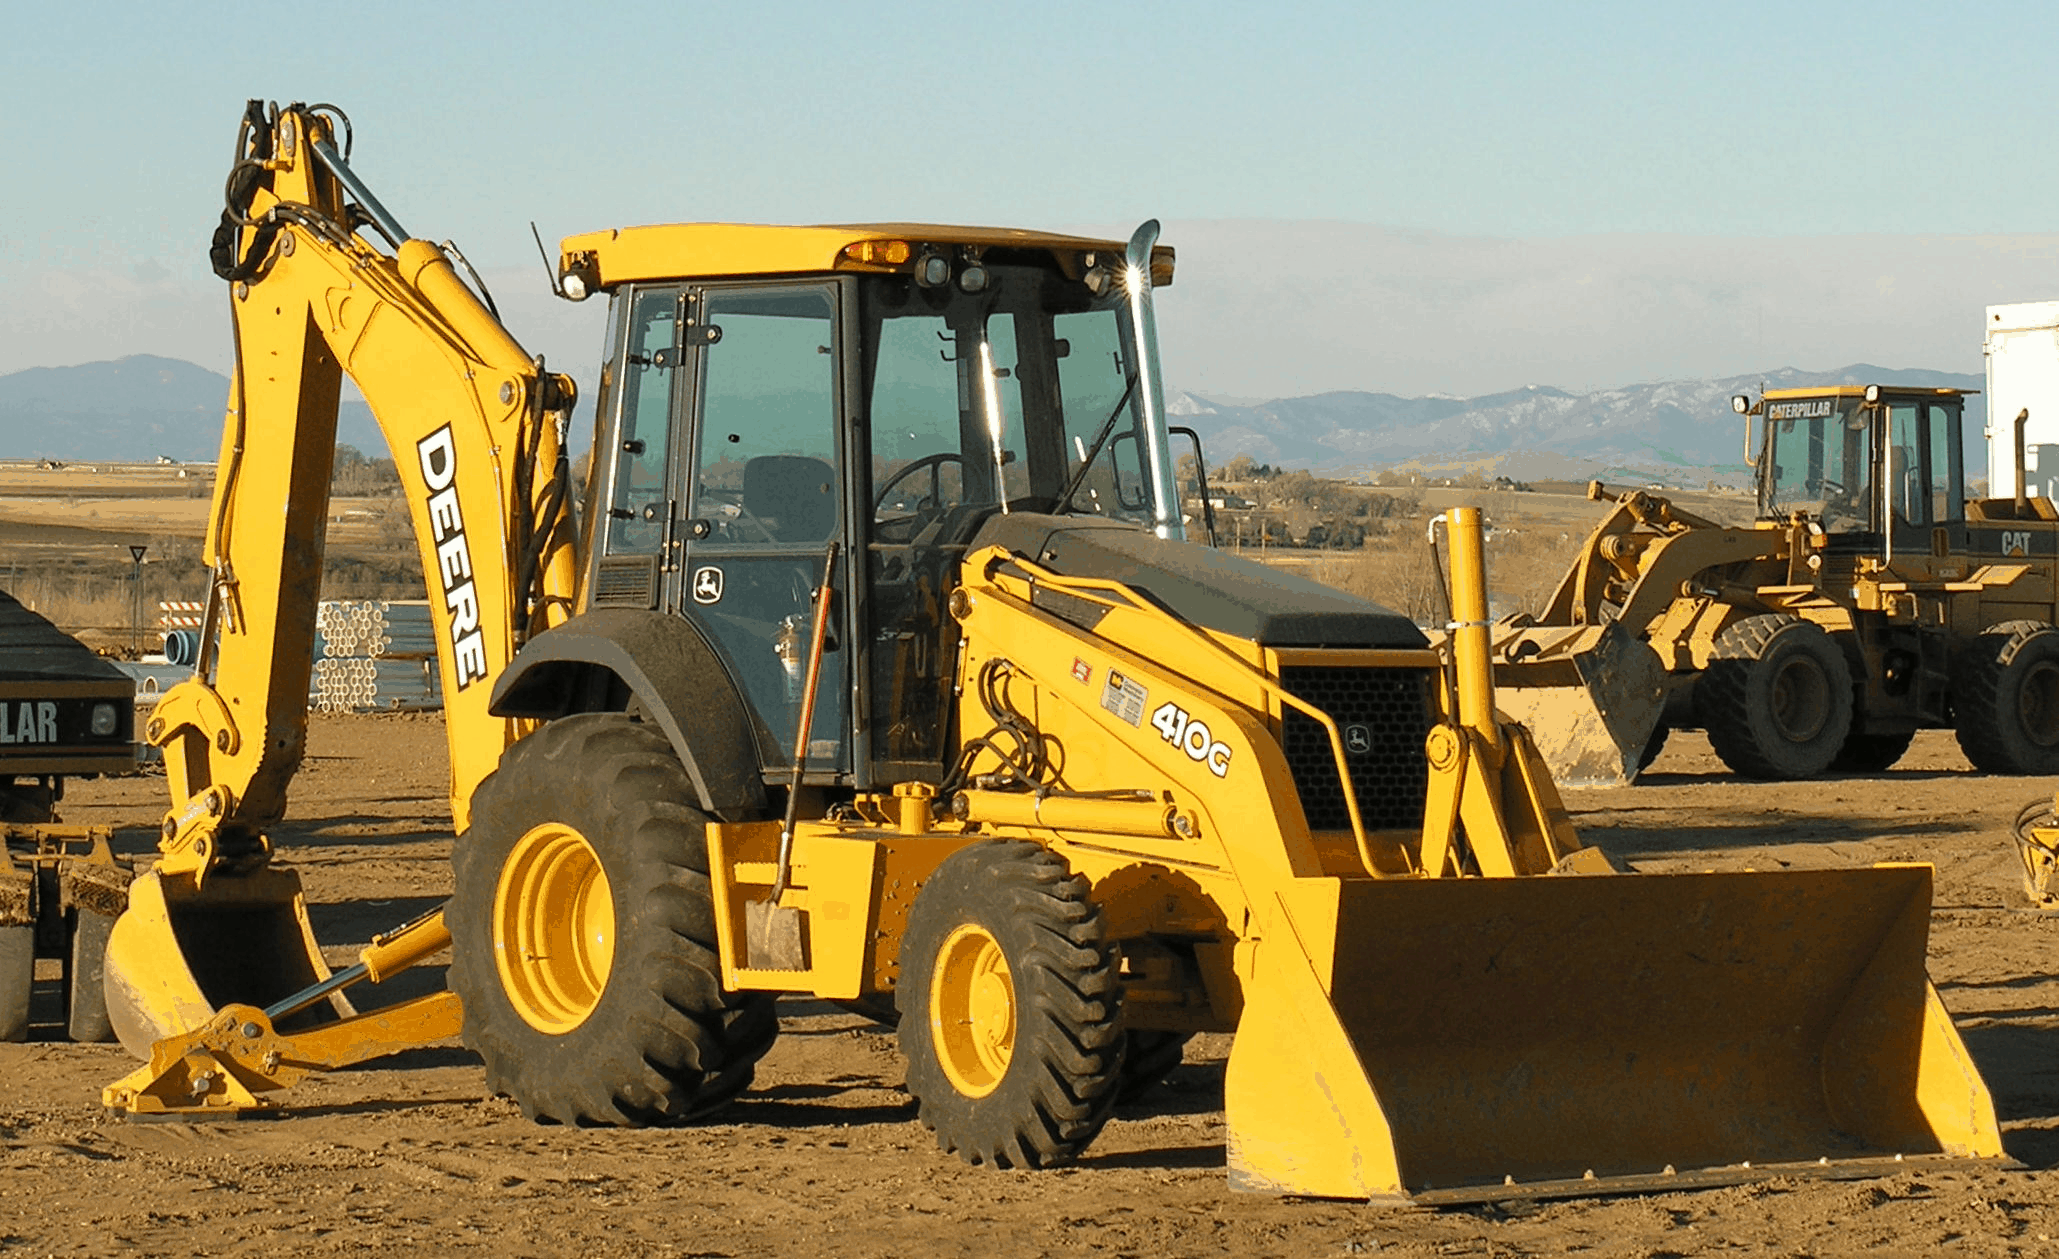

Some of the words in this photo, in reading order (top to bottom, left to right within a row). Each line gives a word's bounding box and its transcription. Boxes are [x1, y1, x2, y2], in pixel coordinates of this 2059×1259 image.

[1768, 401, 1831, 419] CATERPILLAR
[417, 421, 488, 692] DEERE
[2002, 531, 2032, 556] CAT
[0, 702, 57, 743] LAR
[1151, 701, 1233, 779] 410G
